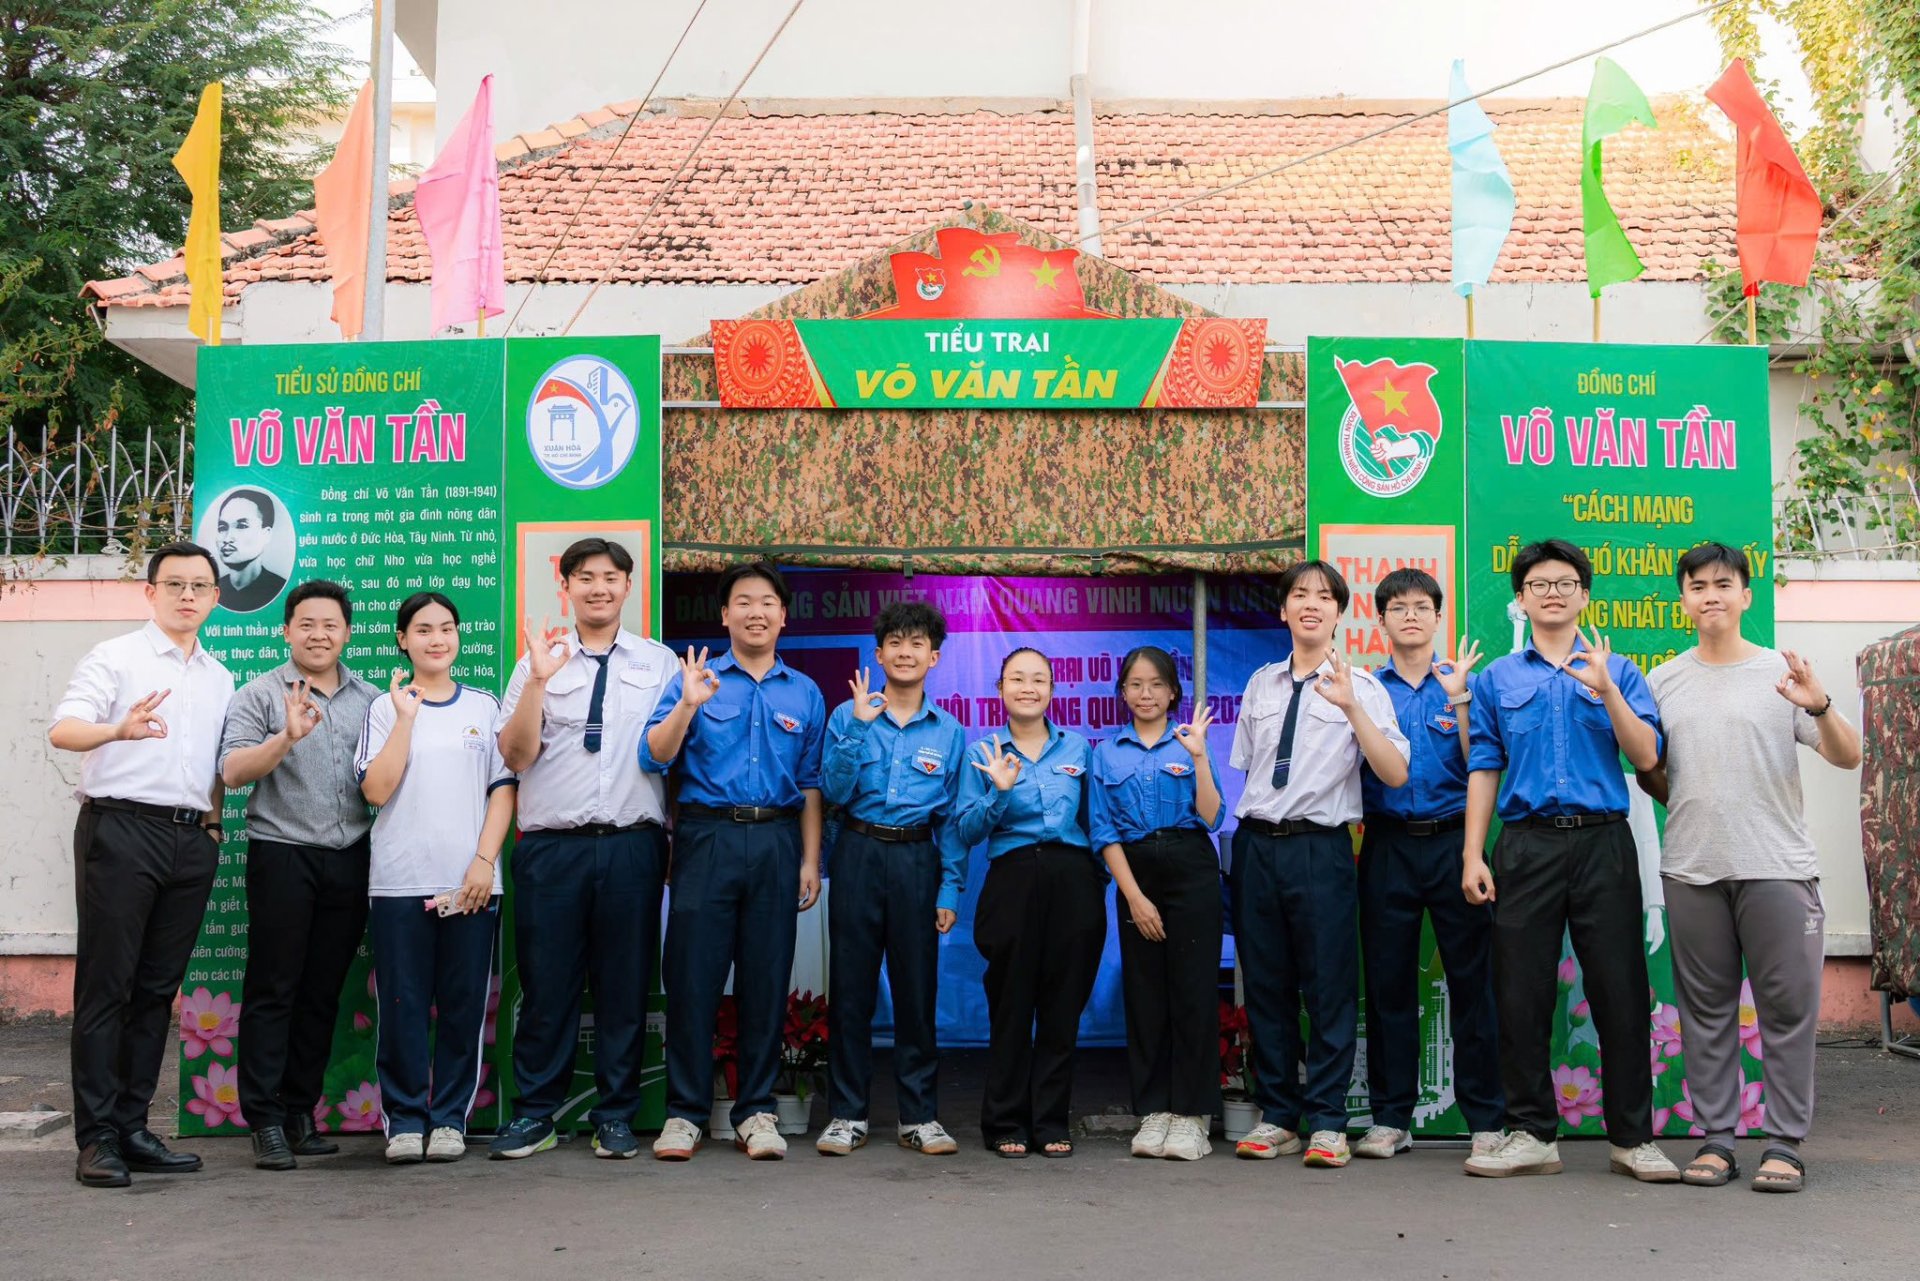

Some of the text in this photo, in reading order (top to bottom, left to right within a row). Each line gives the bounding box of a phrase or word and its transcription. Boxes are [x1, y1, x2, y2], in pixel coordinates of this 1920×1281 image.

[925, 322, 1050, 356] TIỂU TRẠI
[275, 365, 422, 394] TIỂU SỬ ĐỒNG CHÍ
[855, 354, 1118, 399] VÕ VĂN TẦN
[1577, 368, 1656, 395] ĐỒNG CHÍ
[229, 399, 466, 467] VÕ VĂN TẦN
[1500, 405, 1737, 469] VÕ VĂN TẦN
[321, 486, 347, 502] Đồng
[354, 488, 369, 500] chí
[376, 488, 389, 499] Võ
[396, 487, 414, 499] Văn
[421, 484, 439, 498] Tần
[300, 507, 497, 524] sinh ra trong một gia đình nông dân
[1633, 496, 1694, 529] MẠNG
[299, 528, 497, 547] yêu nước ở Đức Hòa, Tây Ninh. Từ nhỏ,
[299, 549, 497, 569] vừa học chữ Nho vừa học nghề
[1492, 535, 1518, 573] DẪ
[1582, 541, 1612, 576] HÓ
[1616, 542, 1673, 577] KHĂN
[1742, 541, 1769, 578] ẤY
[361, 579, 380, 589] sau
[386, 576, 400, 589] đó
[406, 577, 423, 588] mở
[429, 575, 445, 589] lớp
[452, 575, 471, 589] dạy
[477, 575, 496, 589] học
[368, 599, 386, 611] cho
[389, 598, 401, 611] dâ
[822, 582, 870, 618] SẢN
[935, 587, 989, 615] NAM
[999, 587, 1078, 615] QUANG
[1085, 586, 1141, 614] VINH
[1149, 585, 1222, 614] MUN
[1577, 600, 1609, 628] NG
[1612, 592, 1668, 629] NHẤT
[205, 625, 220, 637] Với
[224, 625, 242, 637] tinh
[246, 621, 268, 636] thần
[271, 625, 284, 638] yê
[369, 620, 390, 634] sớm
[475, 619, 495, 632] trào
[231, 647, 254, 661] thực
[259, 646, 279, 659] dân,
[346, 644, 371, 658] giam
[376, 644, 400, 656] như
[461, 641, 496, 656] cường.
[368, 665, 386, 679] sản
[450, 664, 470, 677] Đức
[474, 664, 496, 678] Hòa,
[1088, 652, 1112, 682] VÕ
[975, 697, 1009, 727] TR
[1049, 698, 1081, 726] NG
[220, 896, 240, 913] giết
[205, 919, 225, 935] tấm
[189, 968, 246, 981] cho các th
